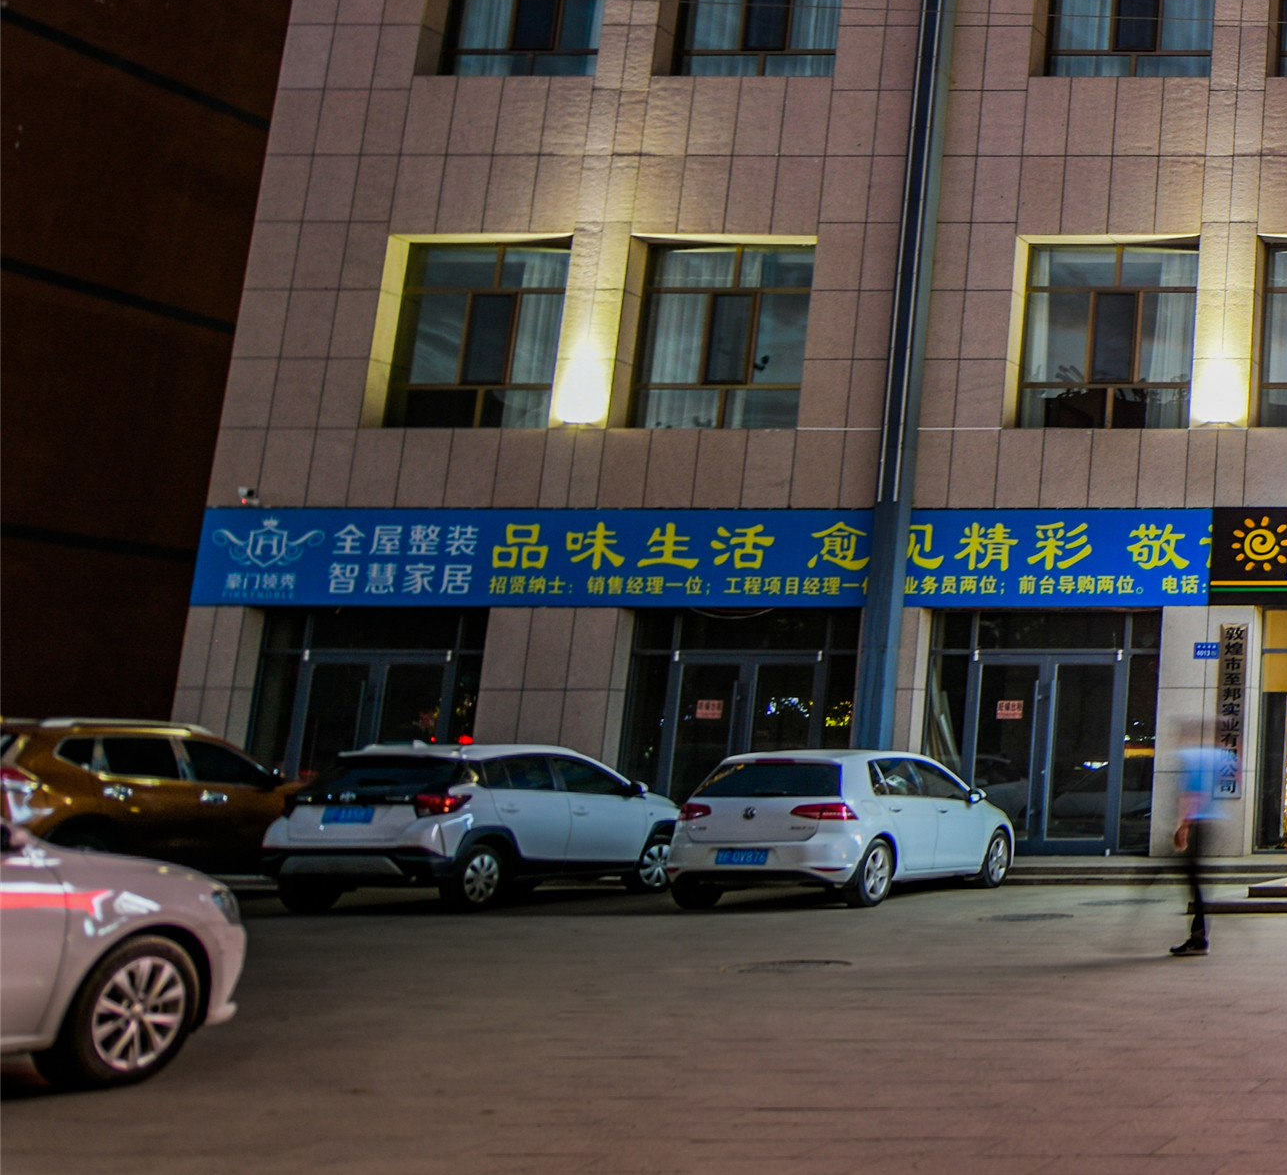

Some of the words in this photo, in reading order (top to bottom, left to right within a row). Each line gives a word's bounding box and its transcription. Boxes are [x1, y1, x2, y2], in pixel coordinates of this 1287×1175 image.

[332, 524, 479, 556] 全屋整装
[492, 522, 775, 570] 品味生活
[225, 572, 297, 590] 豪门领秀
[328, 563, 473, 595] 智慧家居
[1218, 626, 1245, 794] 敦煌市至邦实业有限公司
